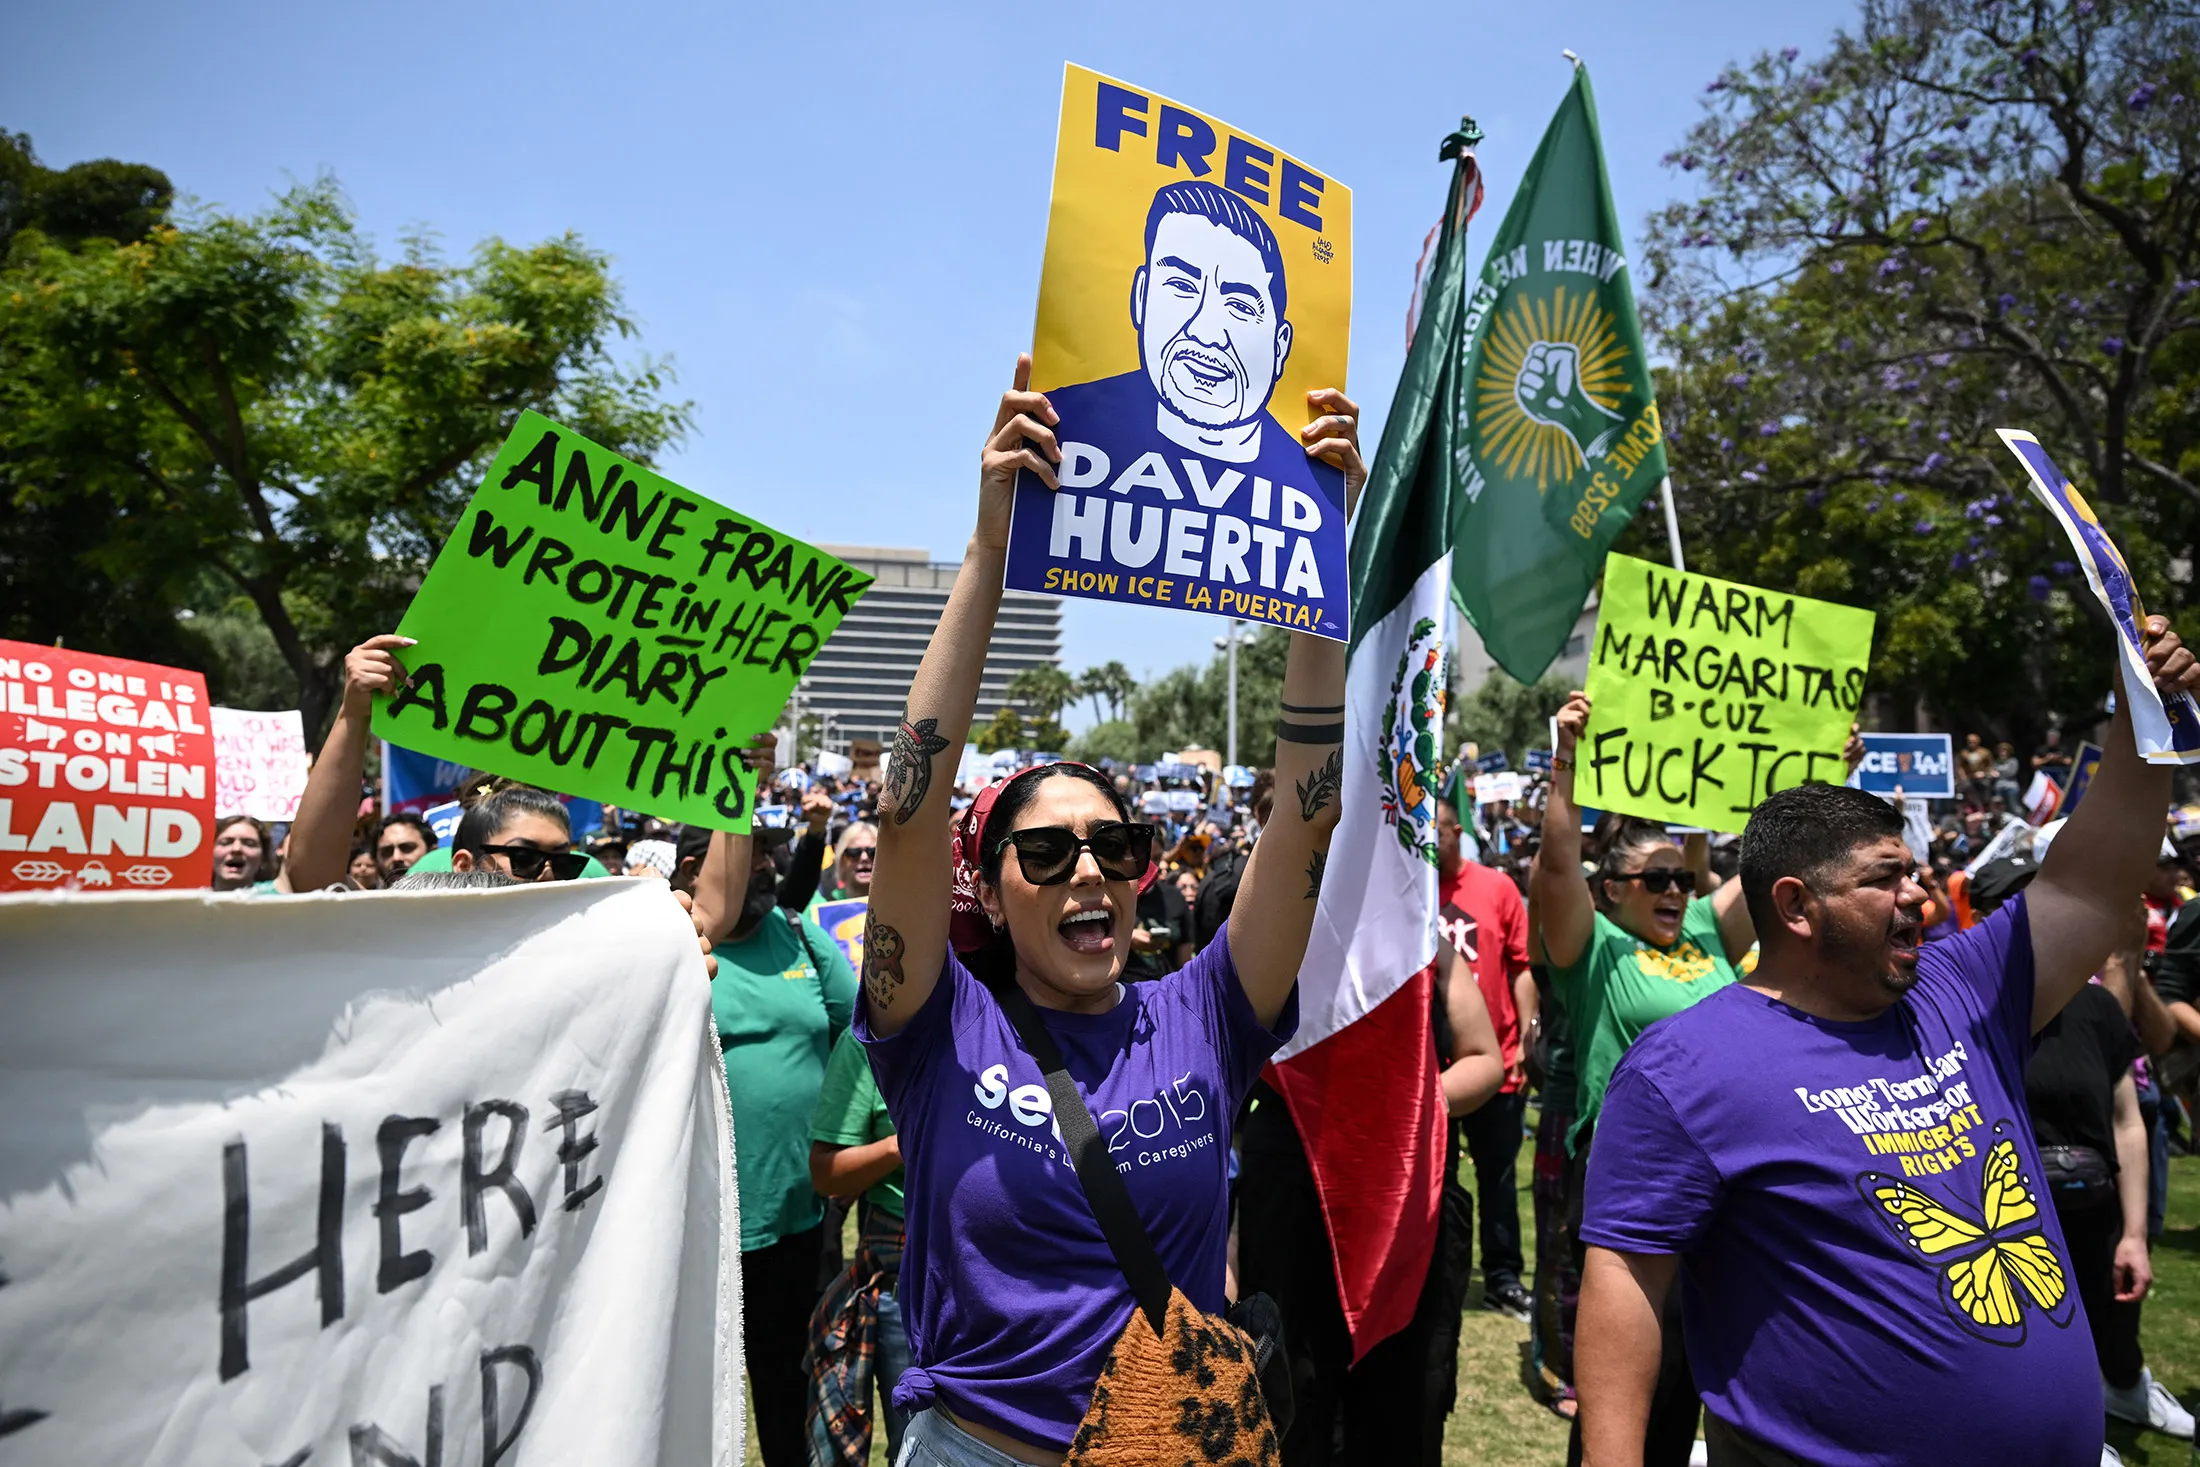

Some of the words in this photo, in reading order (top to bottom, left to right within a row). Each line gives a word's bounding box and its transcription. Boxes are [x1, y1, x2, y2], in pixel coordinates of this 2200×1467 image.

[1095, 81, 1325, 233] FREE
[501, 431, 698, 559] ANNE
[698, 519, 876, 619] FRANK
[1060, 441, 1322, 533] DAVID
[1049, 492, 1325, 599] HUERTA
[468, 510, 677, 628] WROTE
[711, 602, 819, 677] HER
[1044, 567, 1119, 594] SHOW
[1128, 576, 1174, 601] ICE
[1185, 582, 1212, 609] LA
[1219, 588, 1323, 632] PUERTA!
[1647, 570, 1795, 648] WARM
[0, 658, 52, 683] NO
[68, 668, 147, 697] ONE
[160, 681, 196, 704] IS
[537, 616, 728, 716] DIARY
[1599, 622, 1867, 713] MARGARITAS
[73, 729, 132, 755] ON
[387, 663, 631, 770] ABOUT
[0, 748, 206, 800] STOLEN
[1590, 727, 1725, 808] FUCK
[1859, 751, 1898, 774] CE
[0, 798, 203, 858] LAND
[974, 1063, 1062, 1143] se
[1101, 1071, 1205, 1154] 2015
[1794, 1073, 1939, 1113] Long-Term
[1834, 1098, 1953, 1135] Workers
[1945, 1081, 1973, 1108] or
[1862, 1104, 1984, 1156] IMMIGRNT
[966, 1110, 1057, 1160] California's
[1137, 1130, 1215, 1168] Caregivers
[219, 1088, 603, 1384] HERE
